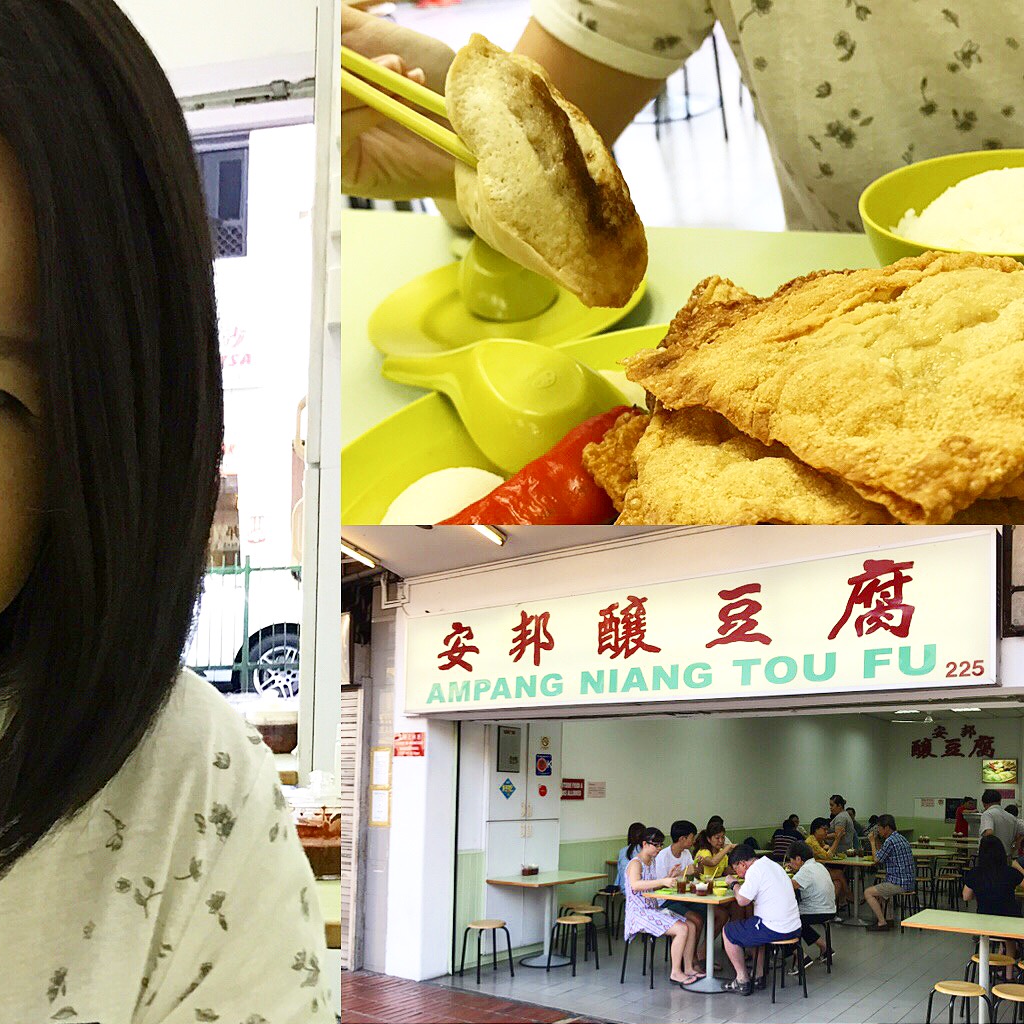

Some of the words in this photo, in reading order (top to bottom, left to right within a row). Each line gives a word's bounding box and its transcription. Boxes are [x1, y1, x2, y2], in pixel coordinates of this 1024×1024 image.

[426, 674, 564, 704] AMPANG
[580, 663, 712, 694] NIANG
[732, 652, 836, 686] TOU
[863, 643, 937, 679] FU
[945, 660, 985, 678] 225
